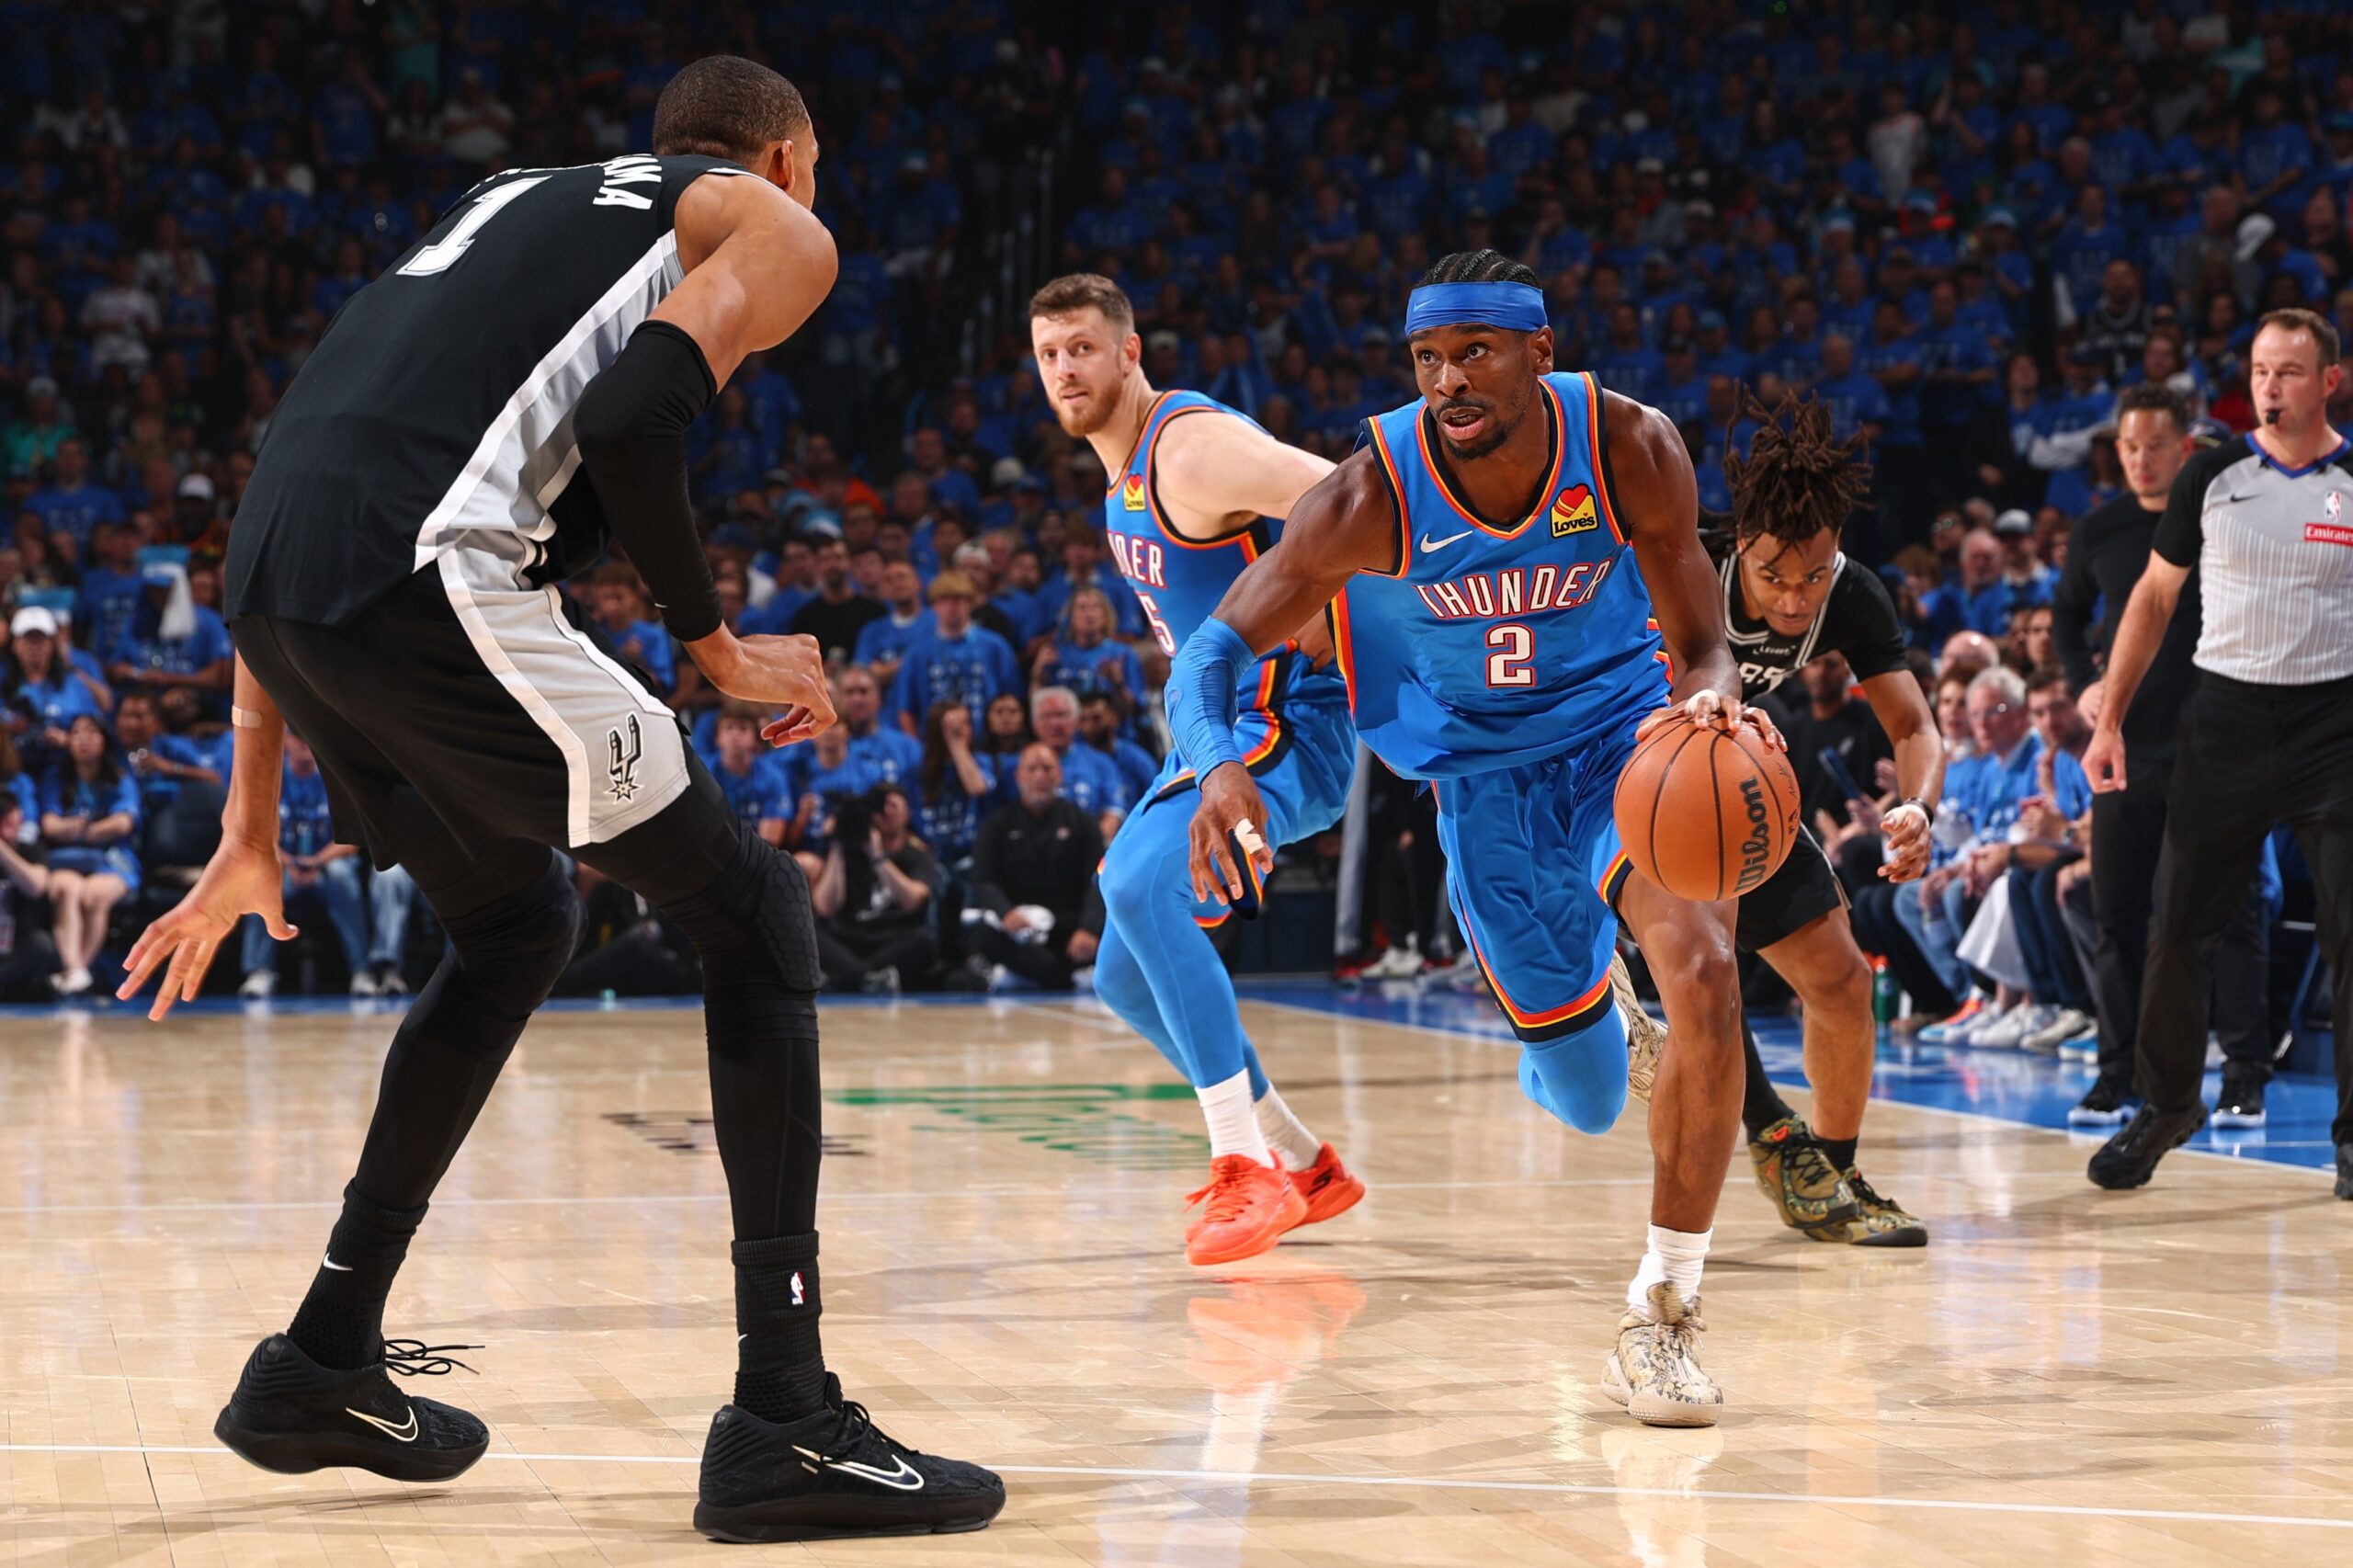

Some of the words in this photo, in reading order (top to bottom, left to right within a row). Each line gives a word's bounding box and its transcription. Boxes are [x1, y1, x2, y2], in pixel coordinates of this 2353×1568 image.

[395, 175, 553, 277] 1
[1413, 557, 1614, 619] THUNDER
[1485, 622, 1537, 688] 2
[1733, 774, 1771, 893] Wilson
